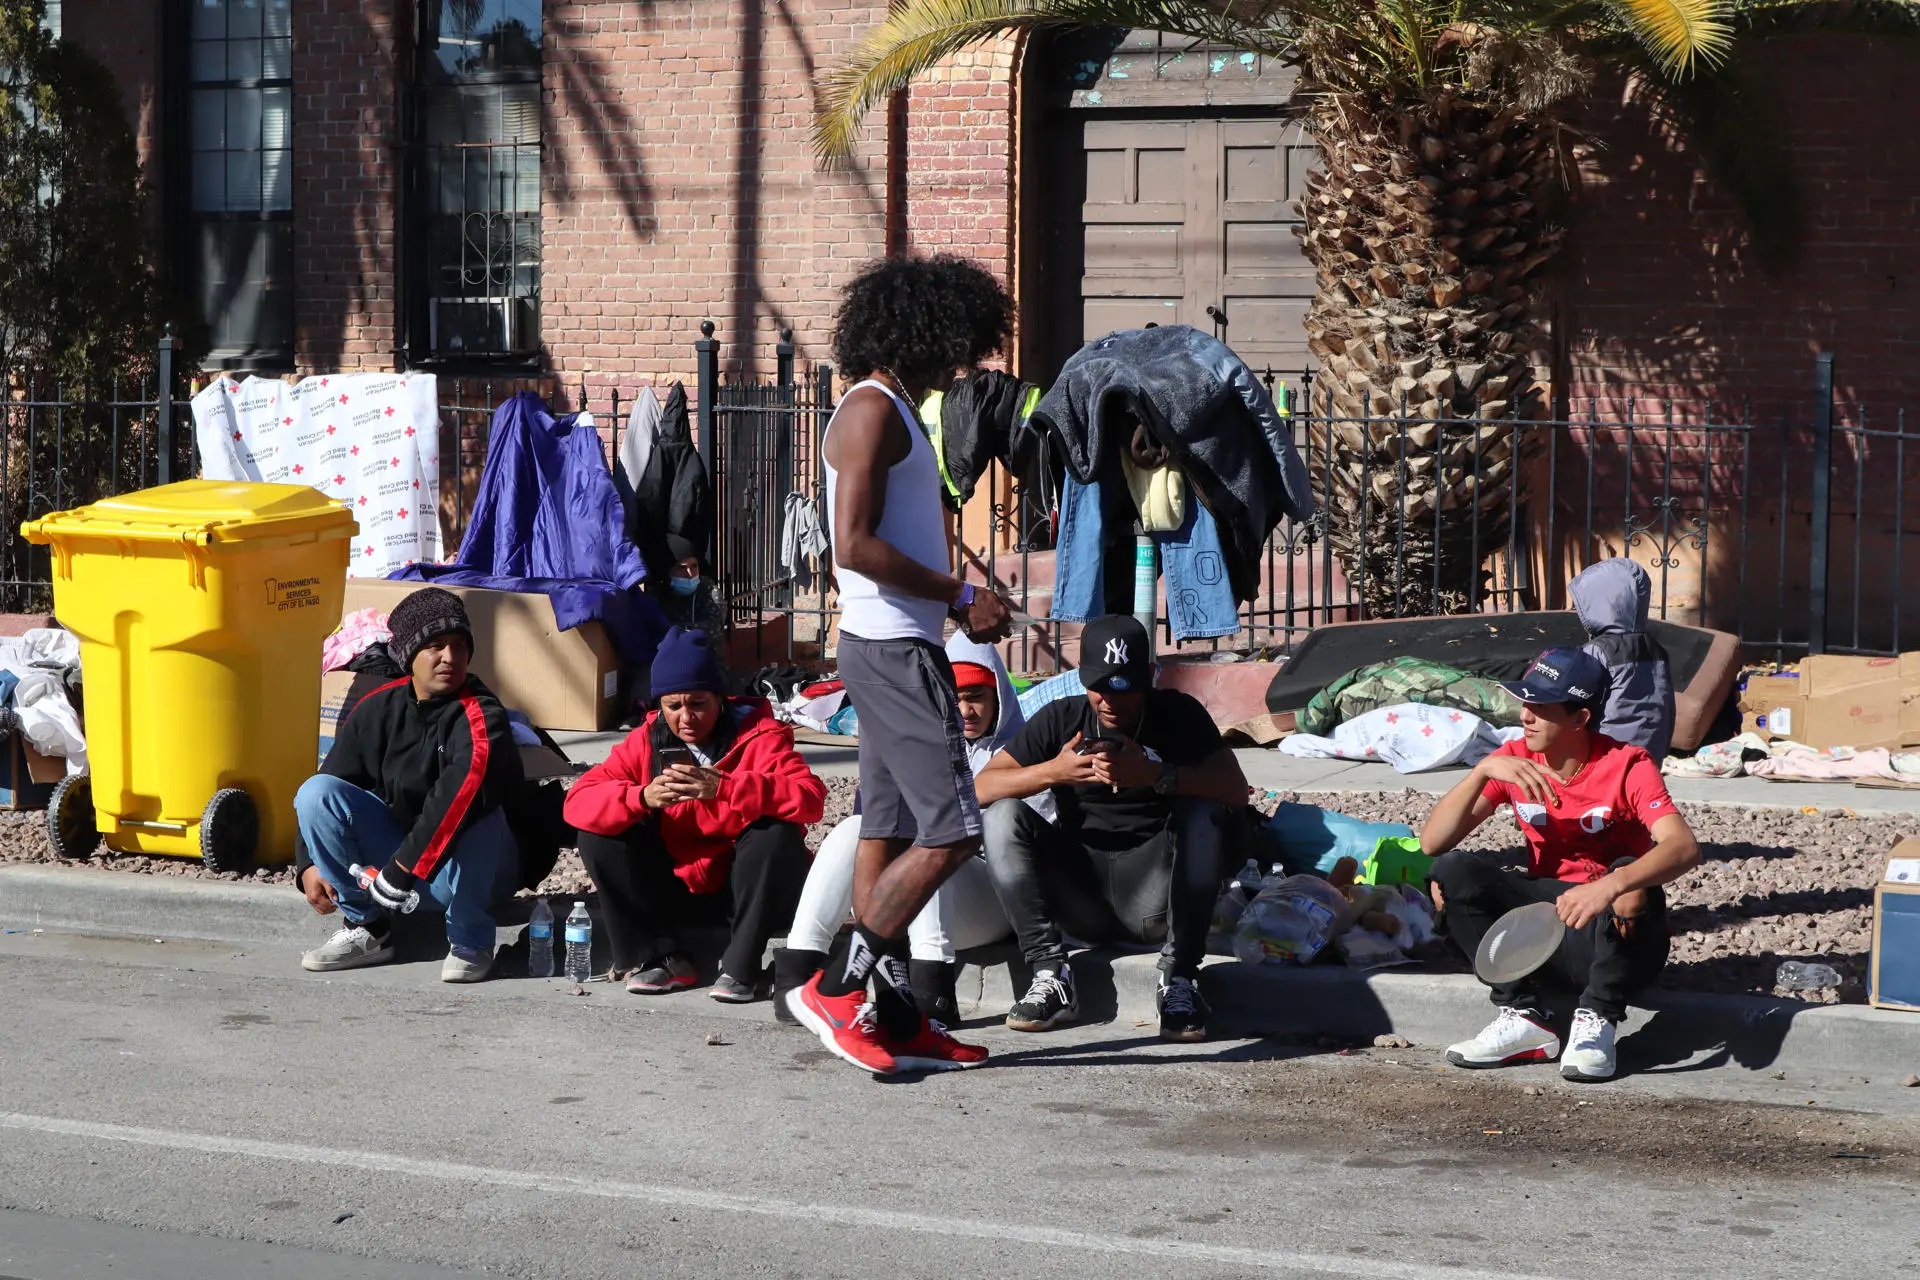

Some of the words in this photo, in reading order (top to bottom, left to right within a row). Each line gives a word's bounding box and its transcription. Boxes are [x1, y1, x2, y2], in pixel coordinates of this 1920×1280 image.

[278, 578, 320, 590] ENVIRONMENTAL
[286, 589, 311, 599] SERVICES
[278, 602, 289, 611] CITY
[298, 599, 304, 607] EL
[306, 598, 320, 606] PASO
[1104, 638, 1129, 664] NY
[1568, 686, 1594, 699] telcel
